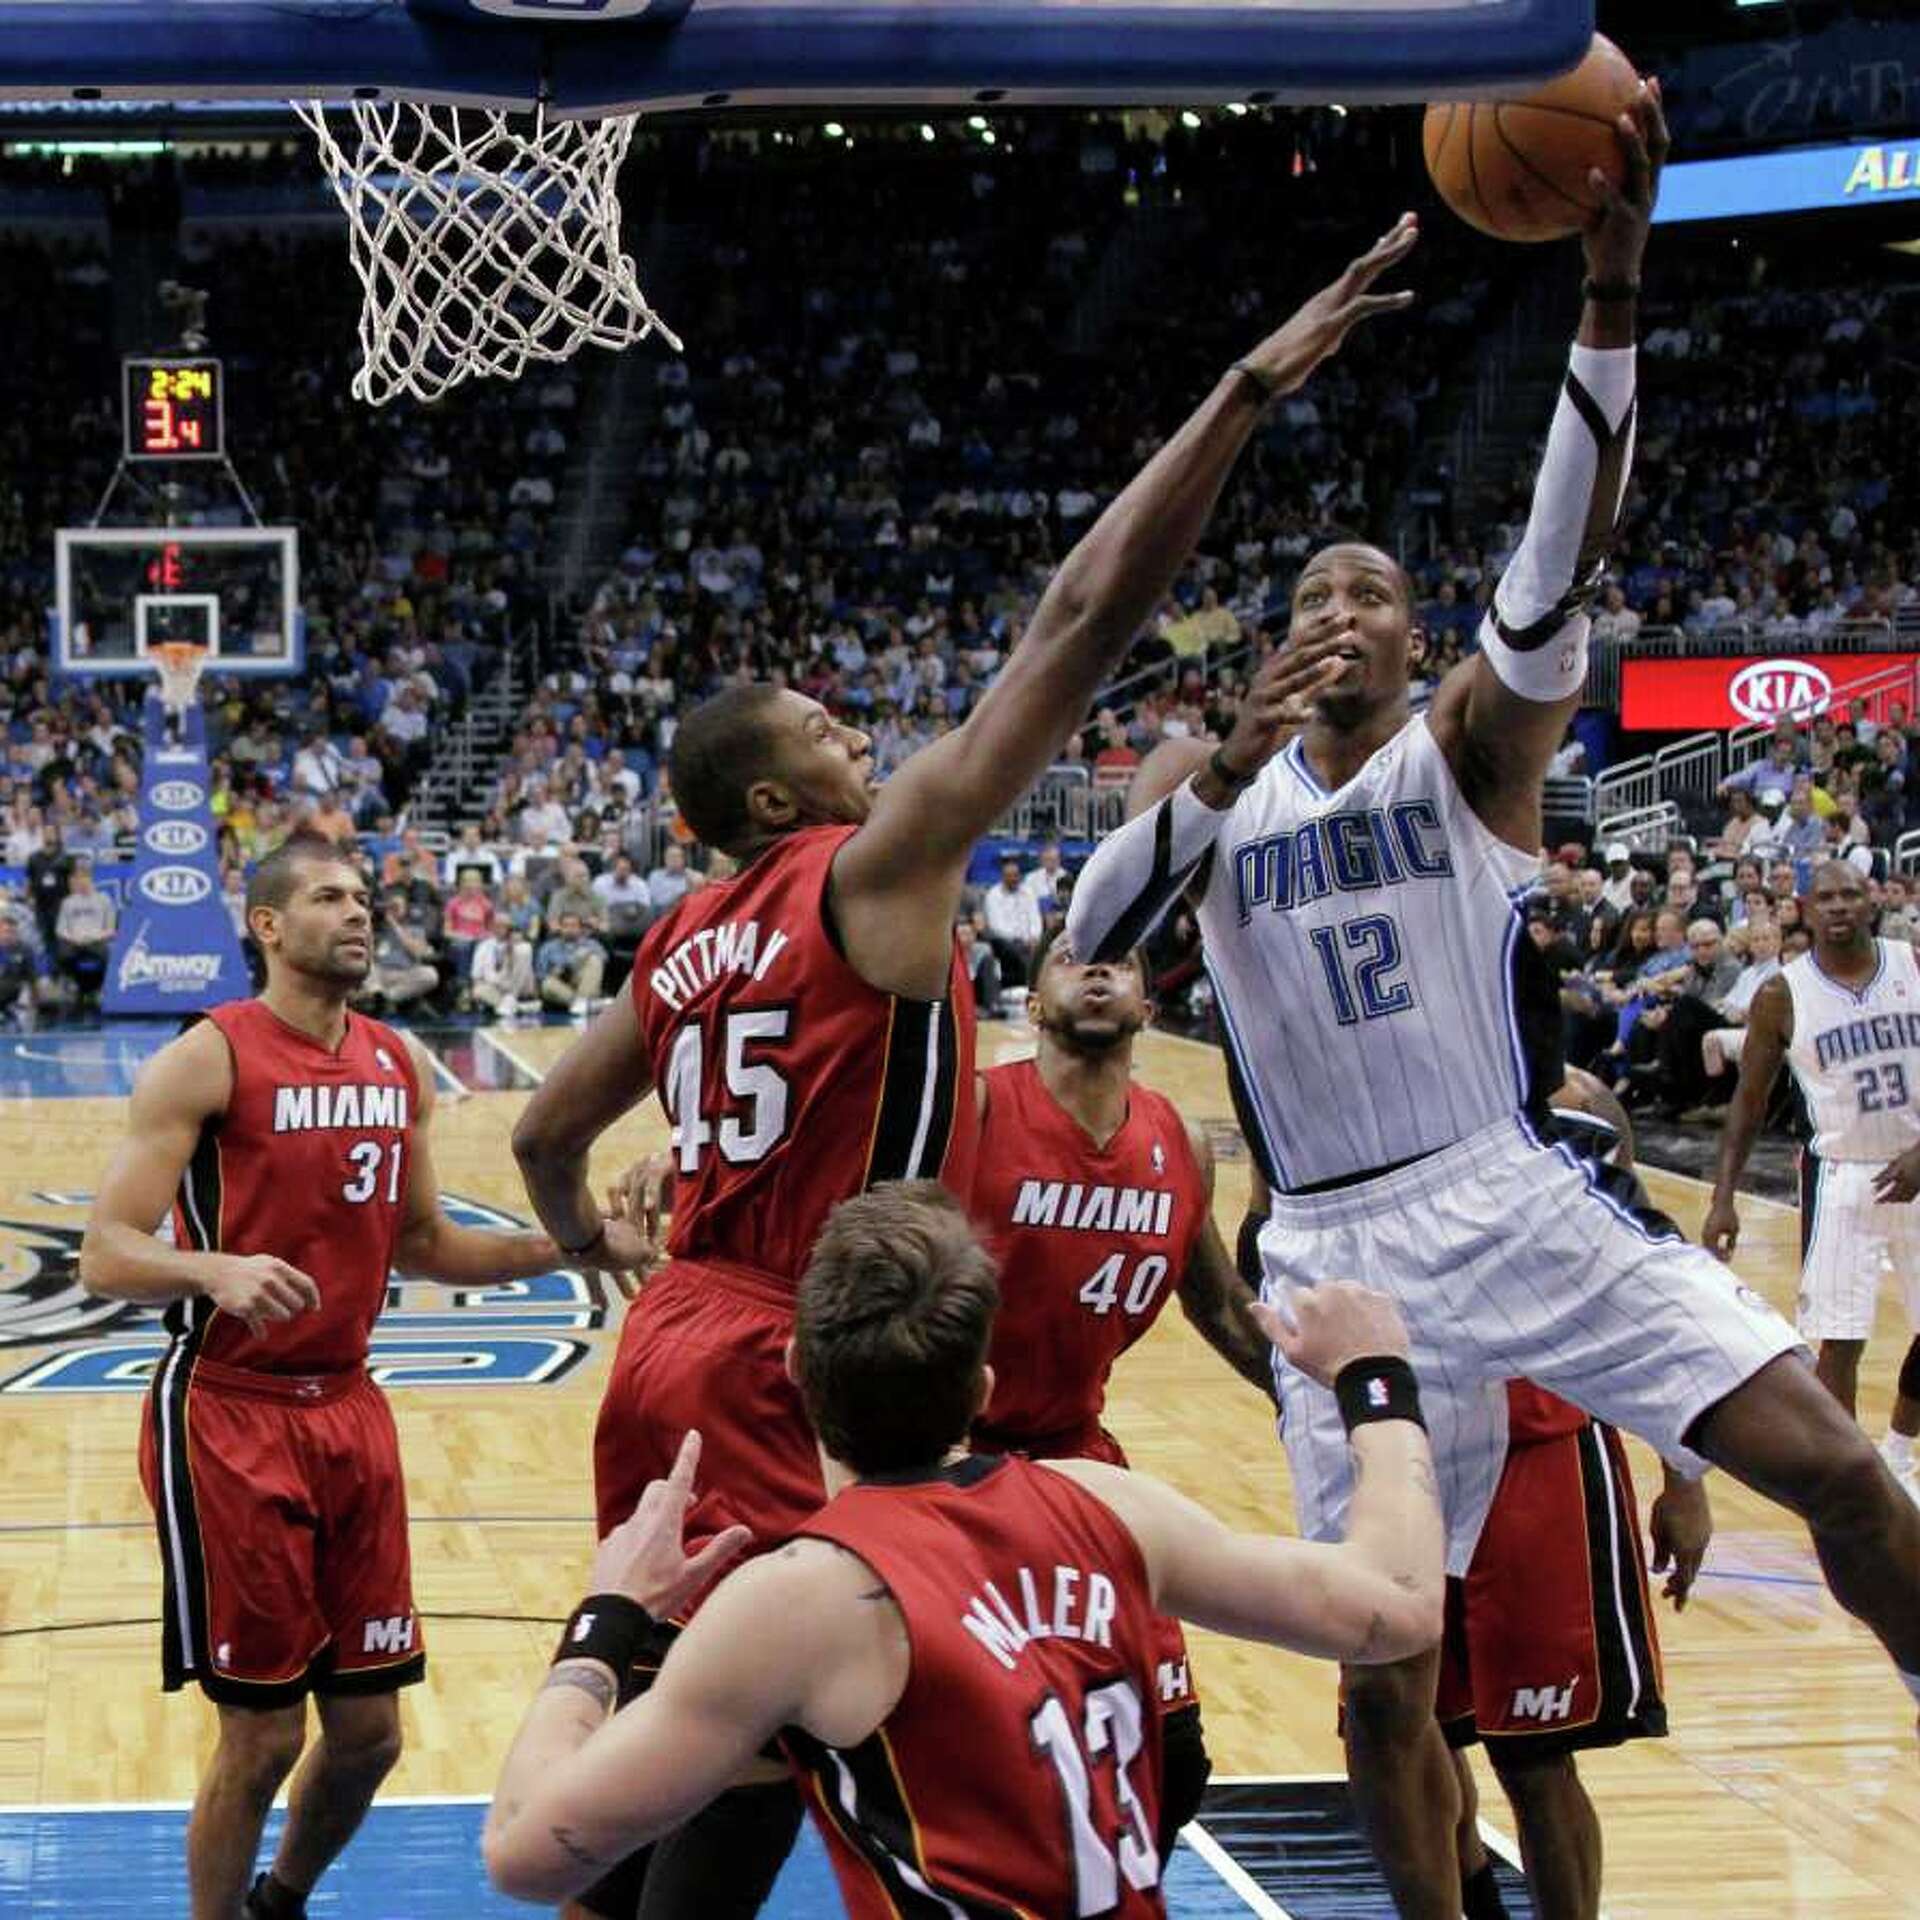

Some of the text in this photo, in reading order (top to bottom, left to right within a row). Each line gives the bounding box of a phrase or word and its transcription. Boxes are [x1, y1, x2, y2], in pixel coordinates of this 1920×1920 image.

[151, 369, 211, 399] 2:24
[1747, 674, 1815, 710] KIA
[1234, 800, 1455, 926] MAGIC
[1310, 914, 1414, 1026] 12
[1815, 1012, 1920, 1072] MAGIC
[273, 1084, 408, 1133] MIAMI
[667, 1009, 790, 1173] 45
[1853, 1062, 1909, 1113] 23
[342, 1140, 402, 1204] 31
[1011, 1180, 1172, 1236] MIAMI
[1079, 1253, 1168, 1316] 40
[961, 1565, 1117, 1670] MILER
[1031, 1682, 1159, 1920] 13
